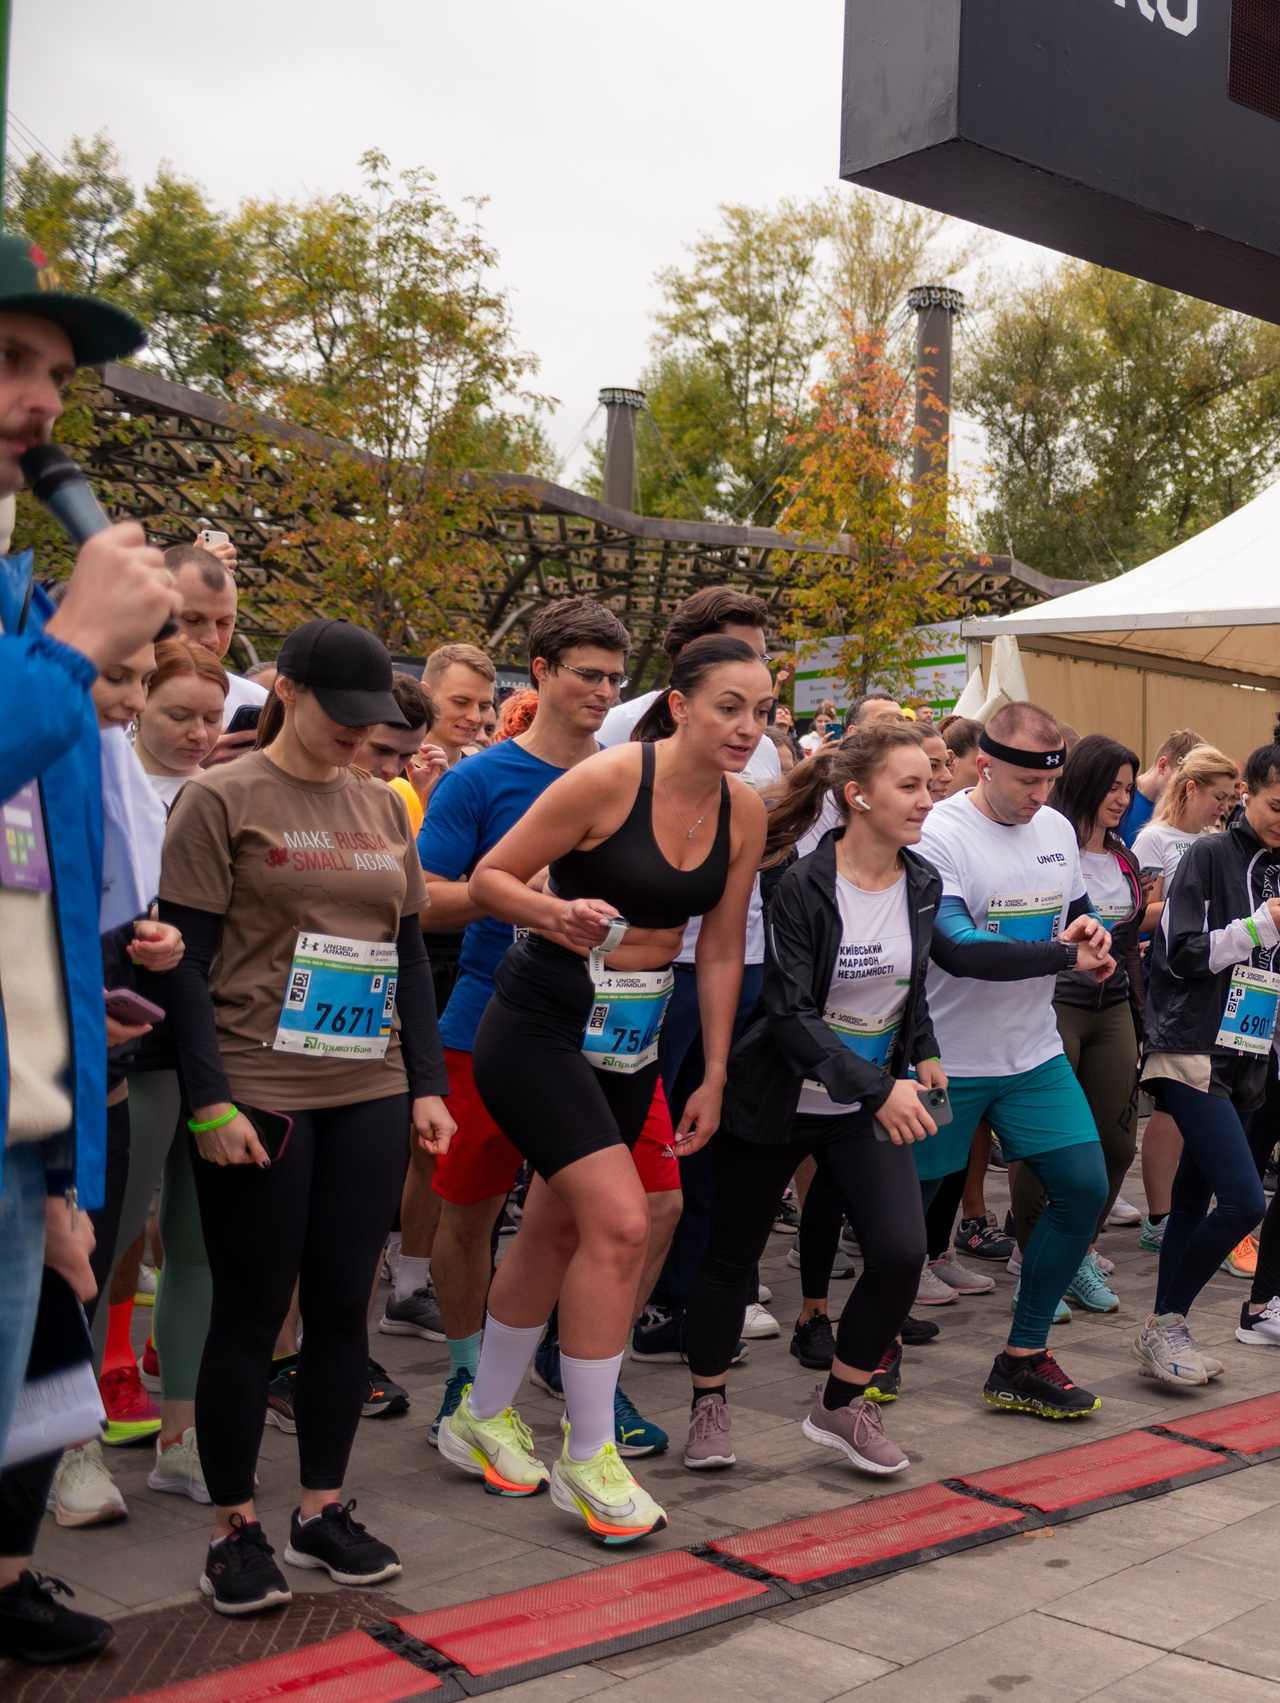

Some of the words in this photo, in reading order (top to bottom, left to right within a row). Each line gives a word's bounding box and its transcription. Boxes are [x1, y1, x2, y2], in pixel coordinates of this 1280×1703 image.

[283, 831, 335, 848] MAKE
[333, 831, 390, 851] RUSSIA
[291, 851, 353, 871] SMALL
[353, 853, 401, 872] AGAIN
[1036, 853, 1065, 864] UNITED
[322, 948, 359, 958] ARMOUR
[323, 943, 354, 952] UNDER
[840, 942, 883, 955] КИЇВСЬКИЙ
[839, 957, 879, 968] МАРАФОН
[837, 965, 894, 979] НЕЗЛАМНОСТІ
[1236, 988, 1243, 997] B
[313, 1002, 374, 1034] 7671
[1240, 1014, 1270, 1037] 6901
[317, 1041, 373, 1054] ПриватБанк
